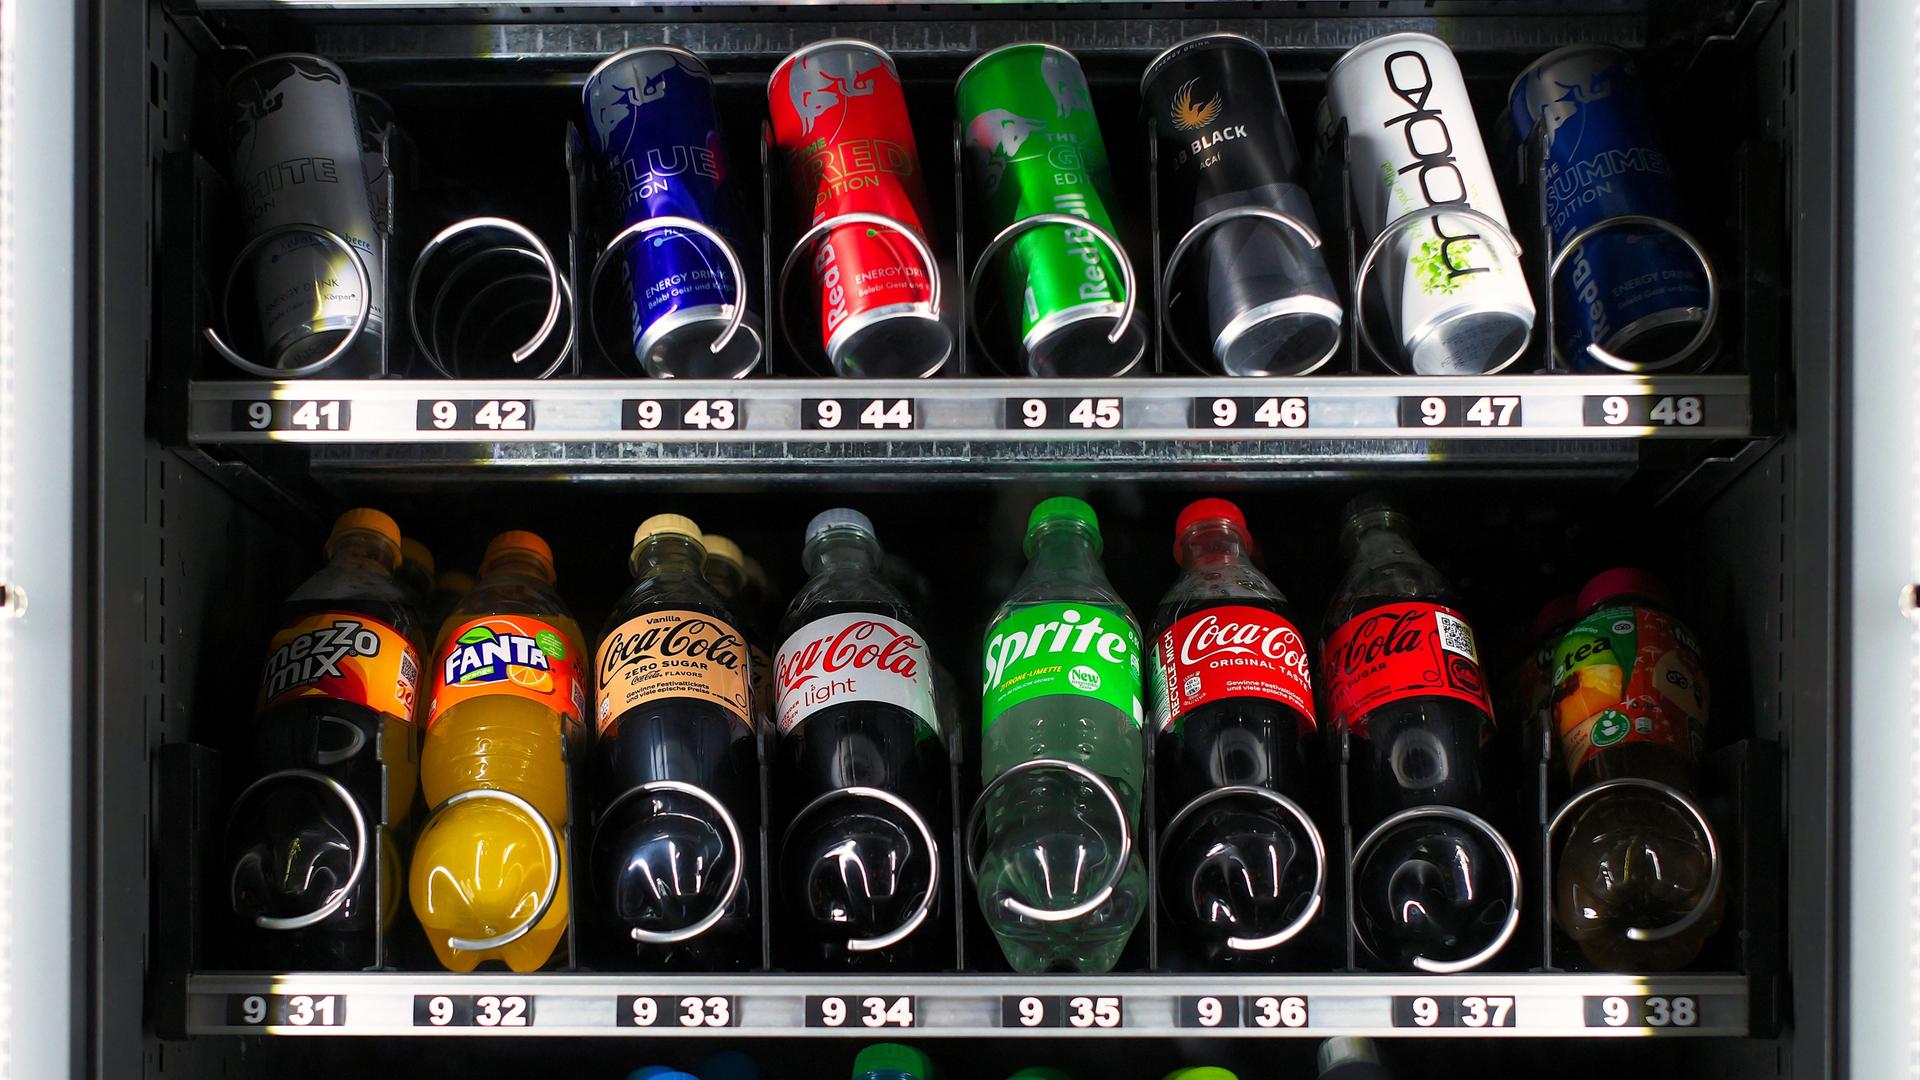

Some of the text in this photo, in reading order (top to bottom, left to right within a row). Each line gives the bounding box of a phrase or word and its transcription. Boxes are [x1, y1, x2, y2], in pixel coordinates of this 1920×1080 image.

[1045, 132, 1077, 142] THE
[1190, 124, 1248, 155] BLACK
[803, 138, 912, 184] RED
[246, 157, 338, 197] HITE
[814, 174, 880, 207] DITION
[1548, 147, 1666, 216] SUMME
[1552, 181, 1612, 231] EDITION
[344, 232, 371, 250] beere
[645, 273, 688, 299] ENERGY
[855, 267, 901, 285] ENERGY
[1066, 245, 1112, 300] Red
[671, 285, 693, 297] Geist
[820, 265, 848, 332] Red
[248, 401, 340, 429] 9 41
[433, 401, 526, 429] 9 42
[638, 400, 735, 428] 9 43
[818, 400, 912, 428] 9 44
[1023, 400, 1120, 428] 9 45
[1213, 399, 1307, 427] 9 46
[1421, 398, 1519, 426] 9 47
[1603, 397, 1702, 425] 9 48
[646, 616, 681, 625] Vanilla
[262, 621, 379, 687] mezzo
[446, 635, 548, 684] FANTA
[600, 619, 743, 689] Coca-Cola
[776, 620, 923, 703] Coca-Cola
[983, 609, 1127, 696] Sprite
[1209, 658, 1276, 670] ORIGINAL
[268, 646, 350, 698] mix
[625, 660, 708, 680] ZERO SUGAR
[1072, 669, 1099, 684] New
[1164, 630, 1180, 717] RECYCLE MICH
[626, 684, 656, 699] Gewinne
[626, 695, 639, 704] und
[640, 689, 656, 698] viele
[805, 677, 857, 708] light
[244, 996, 336, 1025] 9 31
[429, 996, 526, 1026] 9 32
[633, 996, 730, 1026] 9 33
[822, 996, 913, 1027] 9 34
[1019, 997, 1121, 1026] 9 35
[1198, 997, 1307, 1027] 9 36
[1413, 996, 1514, 1026] 9 37
[1603, 996, 1697, 1026] 9 38
